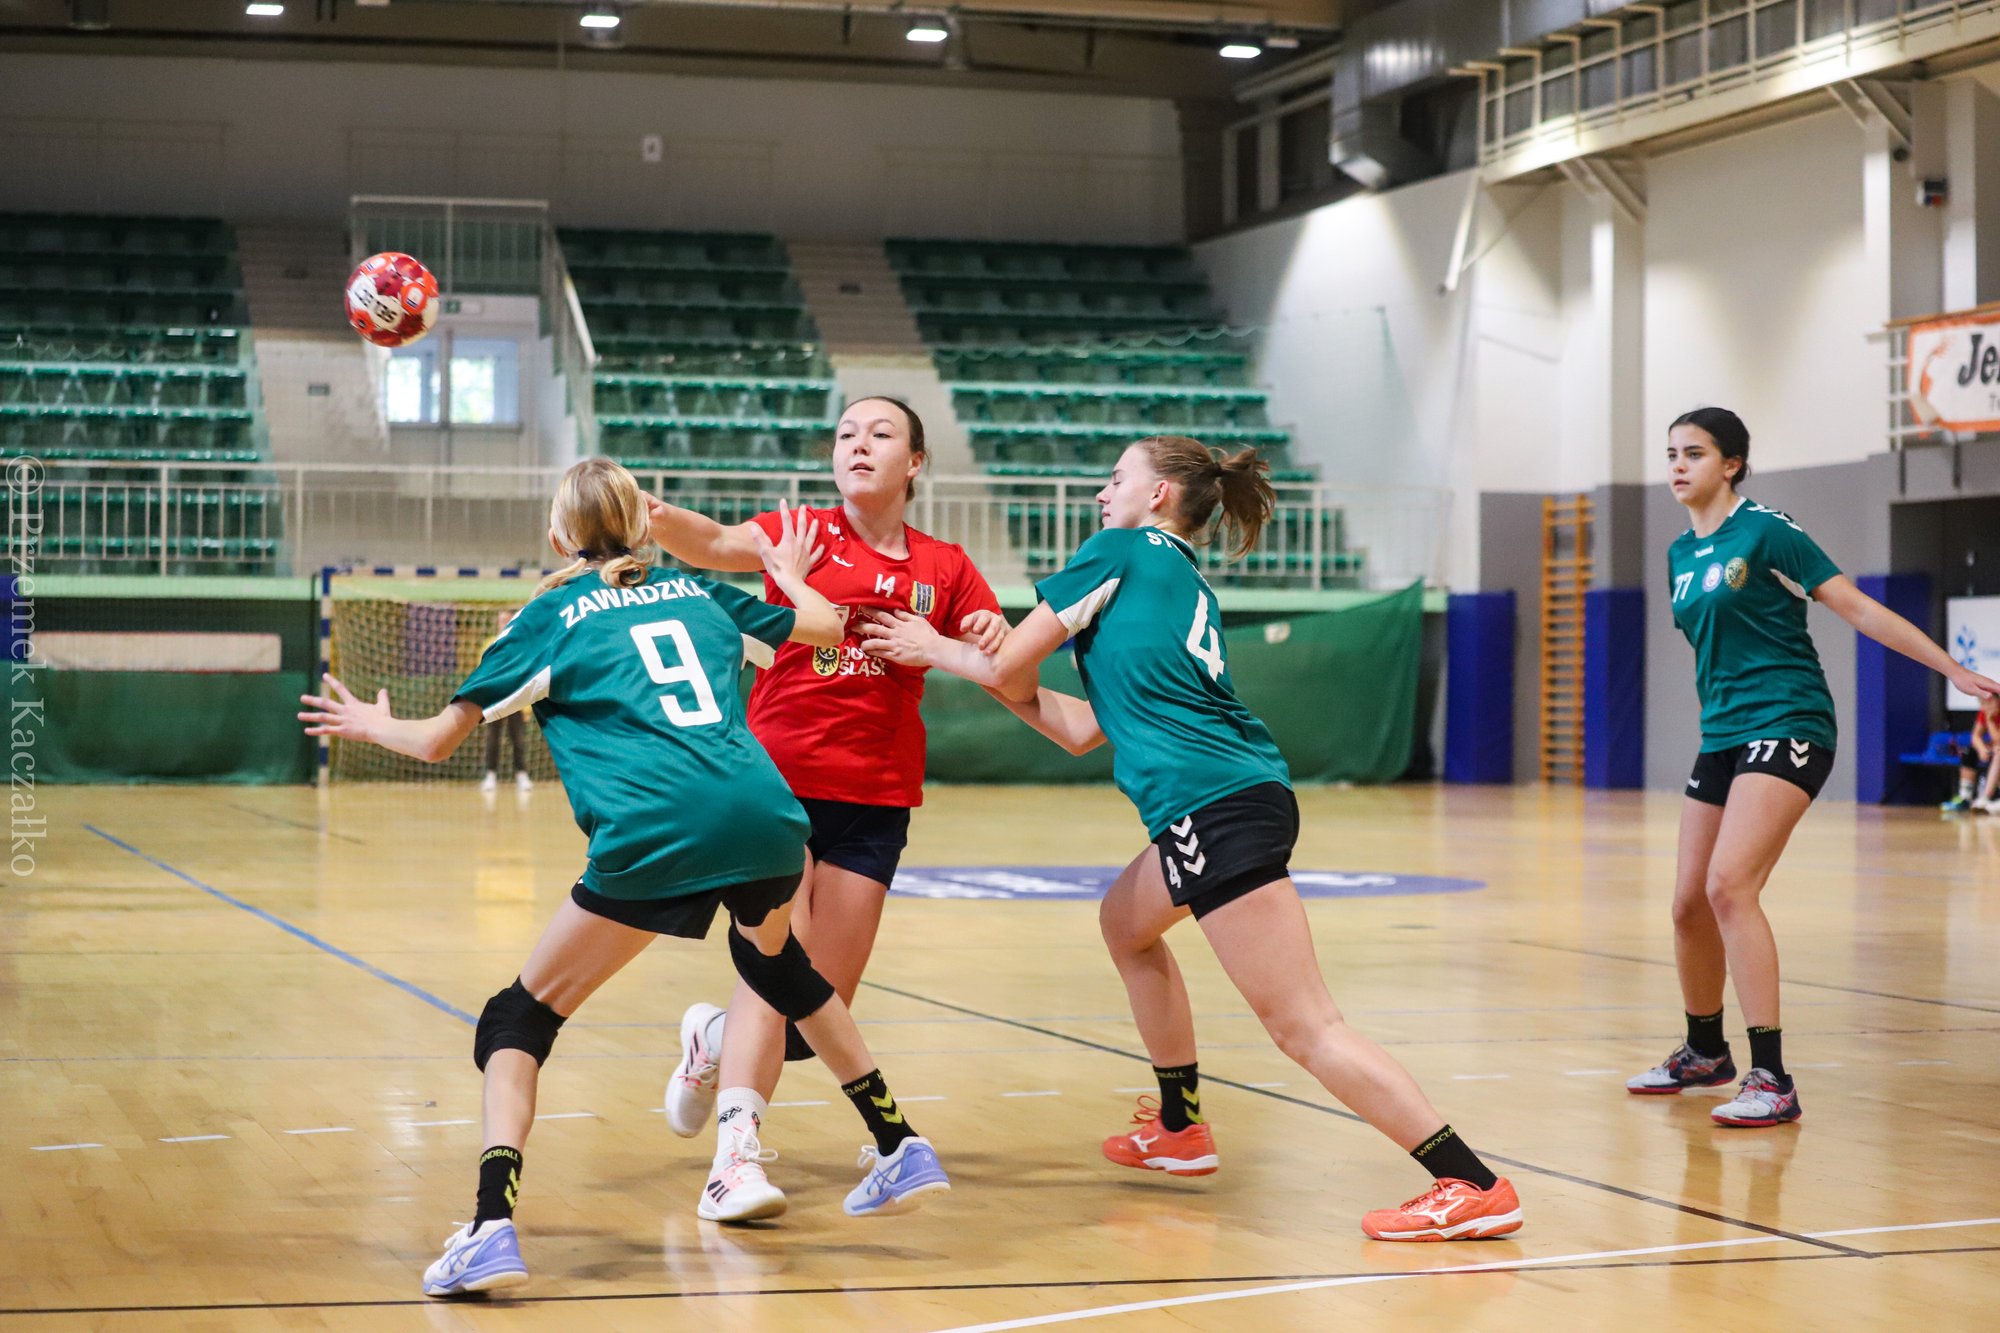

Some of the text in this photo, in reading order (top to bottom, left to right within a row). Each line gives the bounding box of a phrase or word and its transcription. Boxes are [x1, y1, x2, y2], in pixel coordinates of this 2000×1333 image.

[1957, 332, 2000, 386] Je
[874, 572, 896, 598] 14
[1672, 570, 1695, 603] 77
[558, 577, 711, 630] ZAWADZKA
[1185, 588, 1225, 682] 4
[629, 618, 723, 728] 9
[1746, 739, 1780, 764] 77
[1165, 855, 1182, 889] 4
[480, 1148, 520, 1166] ANDBALL
